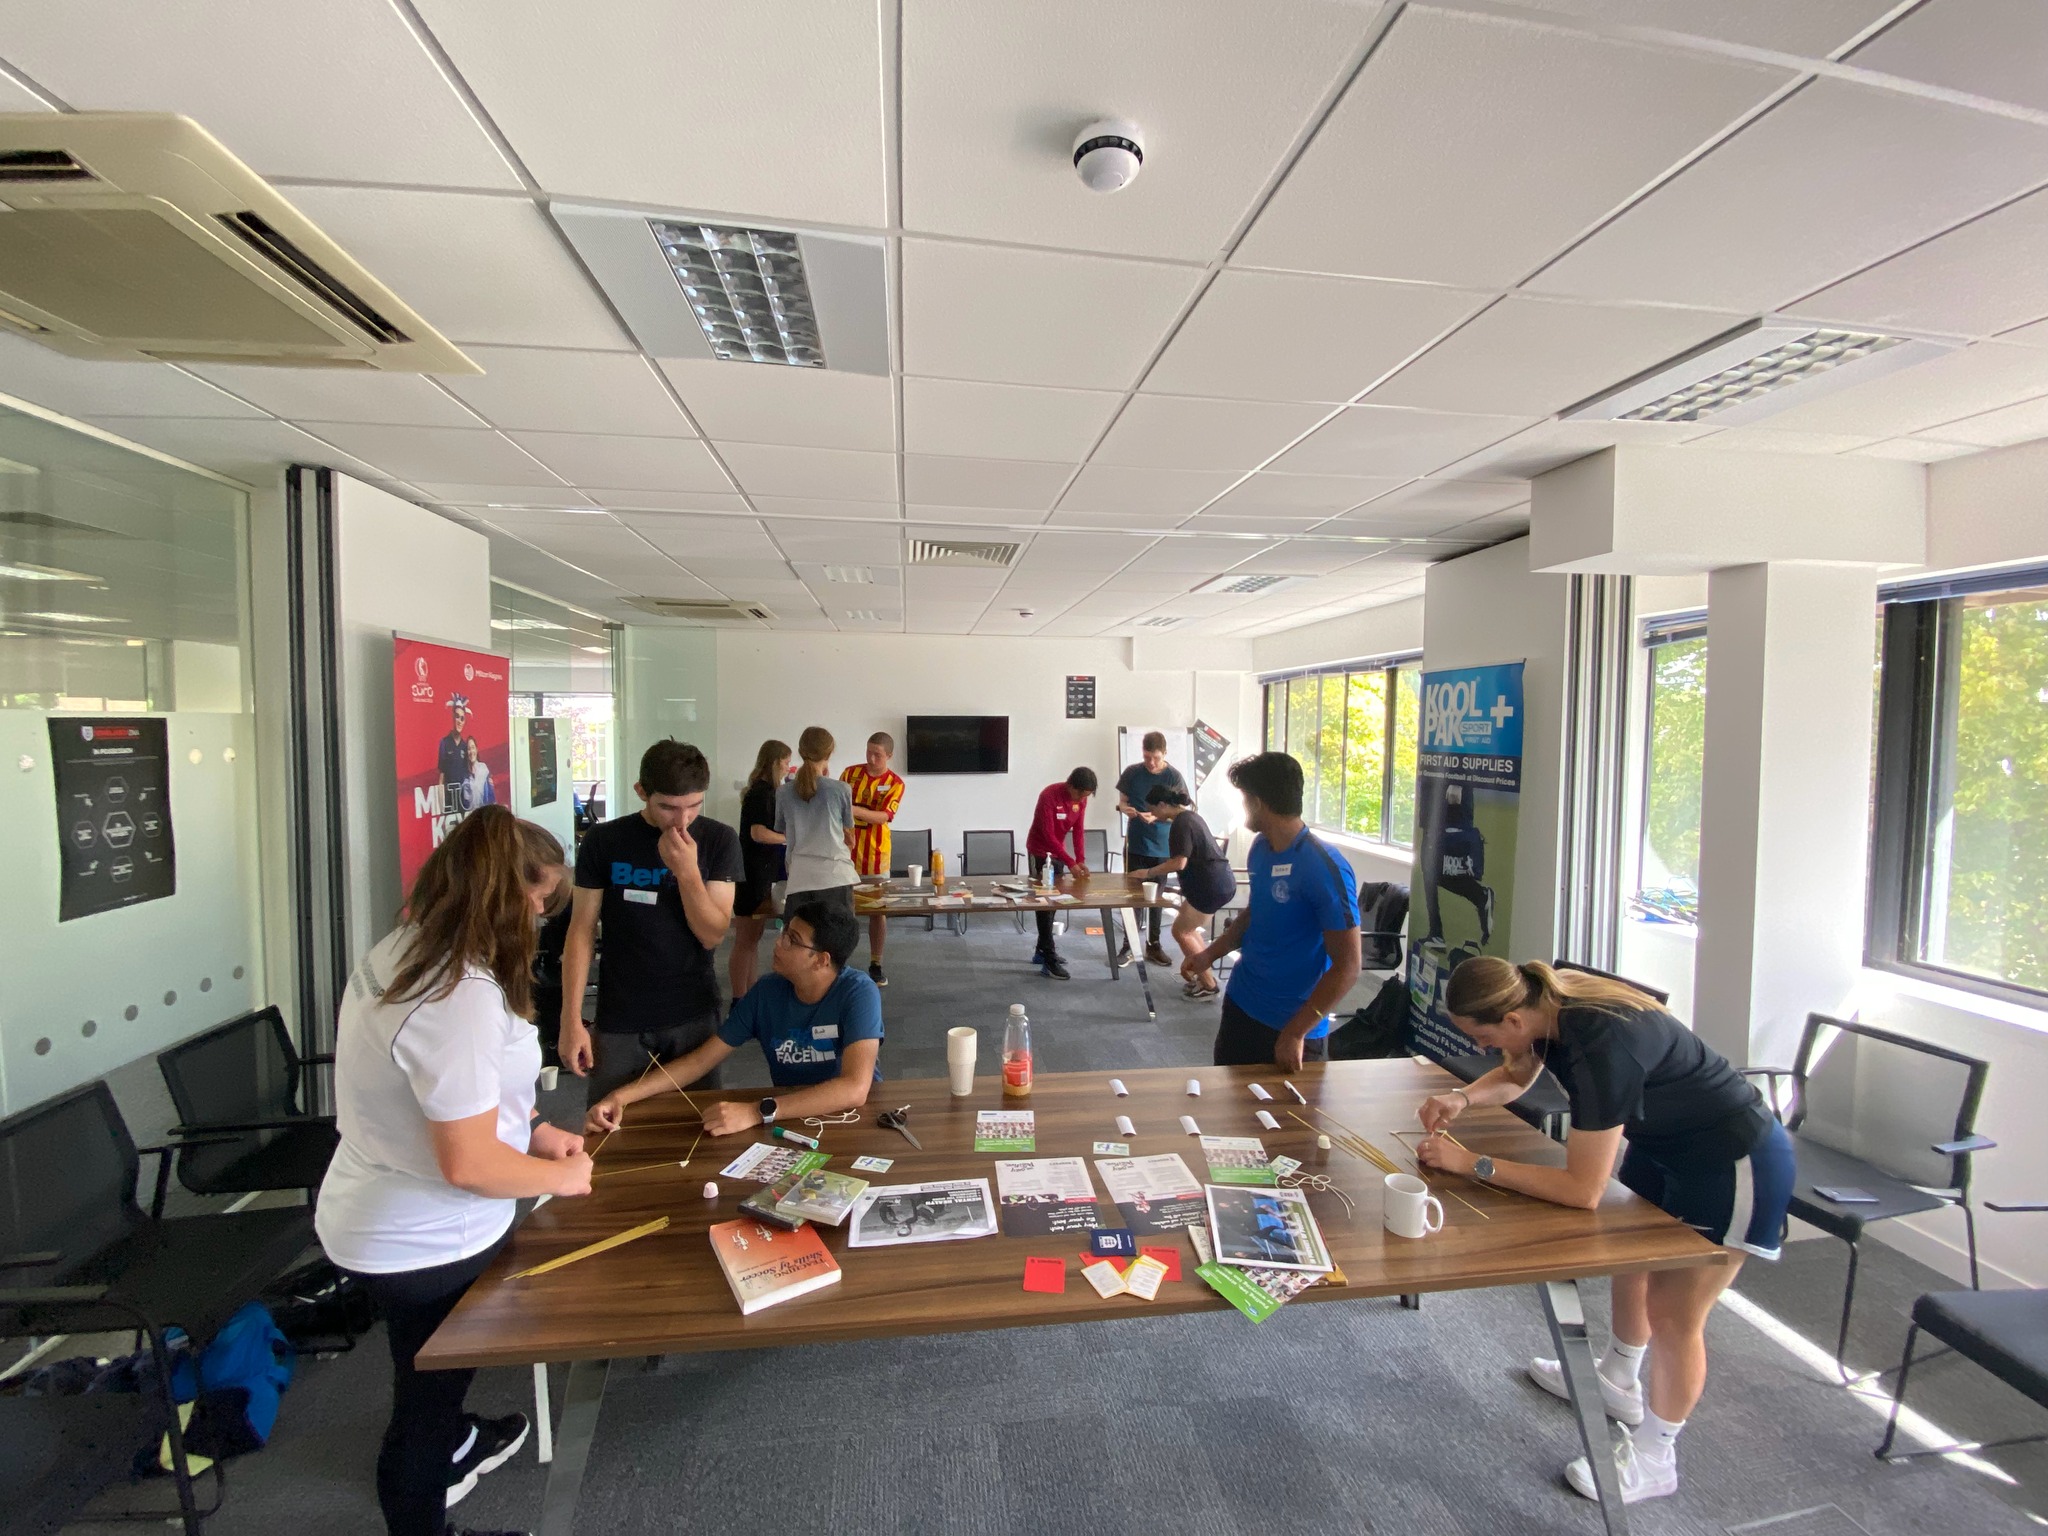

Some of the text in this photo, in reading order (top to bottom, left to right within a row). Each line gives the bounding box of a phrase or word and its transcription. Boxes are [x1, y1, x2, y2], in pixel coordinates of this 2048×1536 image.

[1425, 680, 1482, 717] KOOL
[1424, 712, 1491, 747] PAK SPORT
[1419, 754, 1513, 773] FIRST AID SUPPLIES
[1445, 772, 1466, 781] Football
[1473, 775, 1495, 784] Discount
[1496, 777, 1515, 786] Prices
[1419, 1025, 1440, 1043] County
[1441, 1036, 1450, 1048] FA
[1451, 1042, 1458, 1052] to
[1435, 1022, 1471, 1048] partnership
[776, 1050, 812, 1064] FACE
[774, 1258, 825, 1280] TEACHING
[779, 1260, 791, 1272] of
[792, 1250, 823, 1269] Skills
[740, 1265, 777, 1283] Soccer
